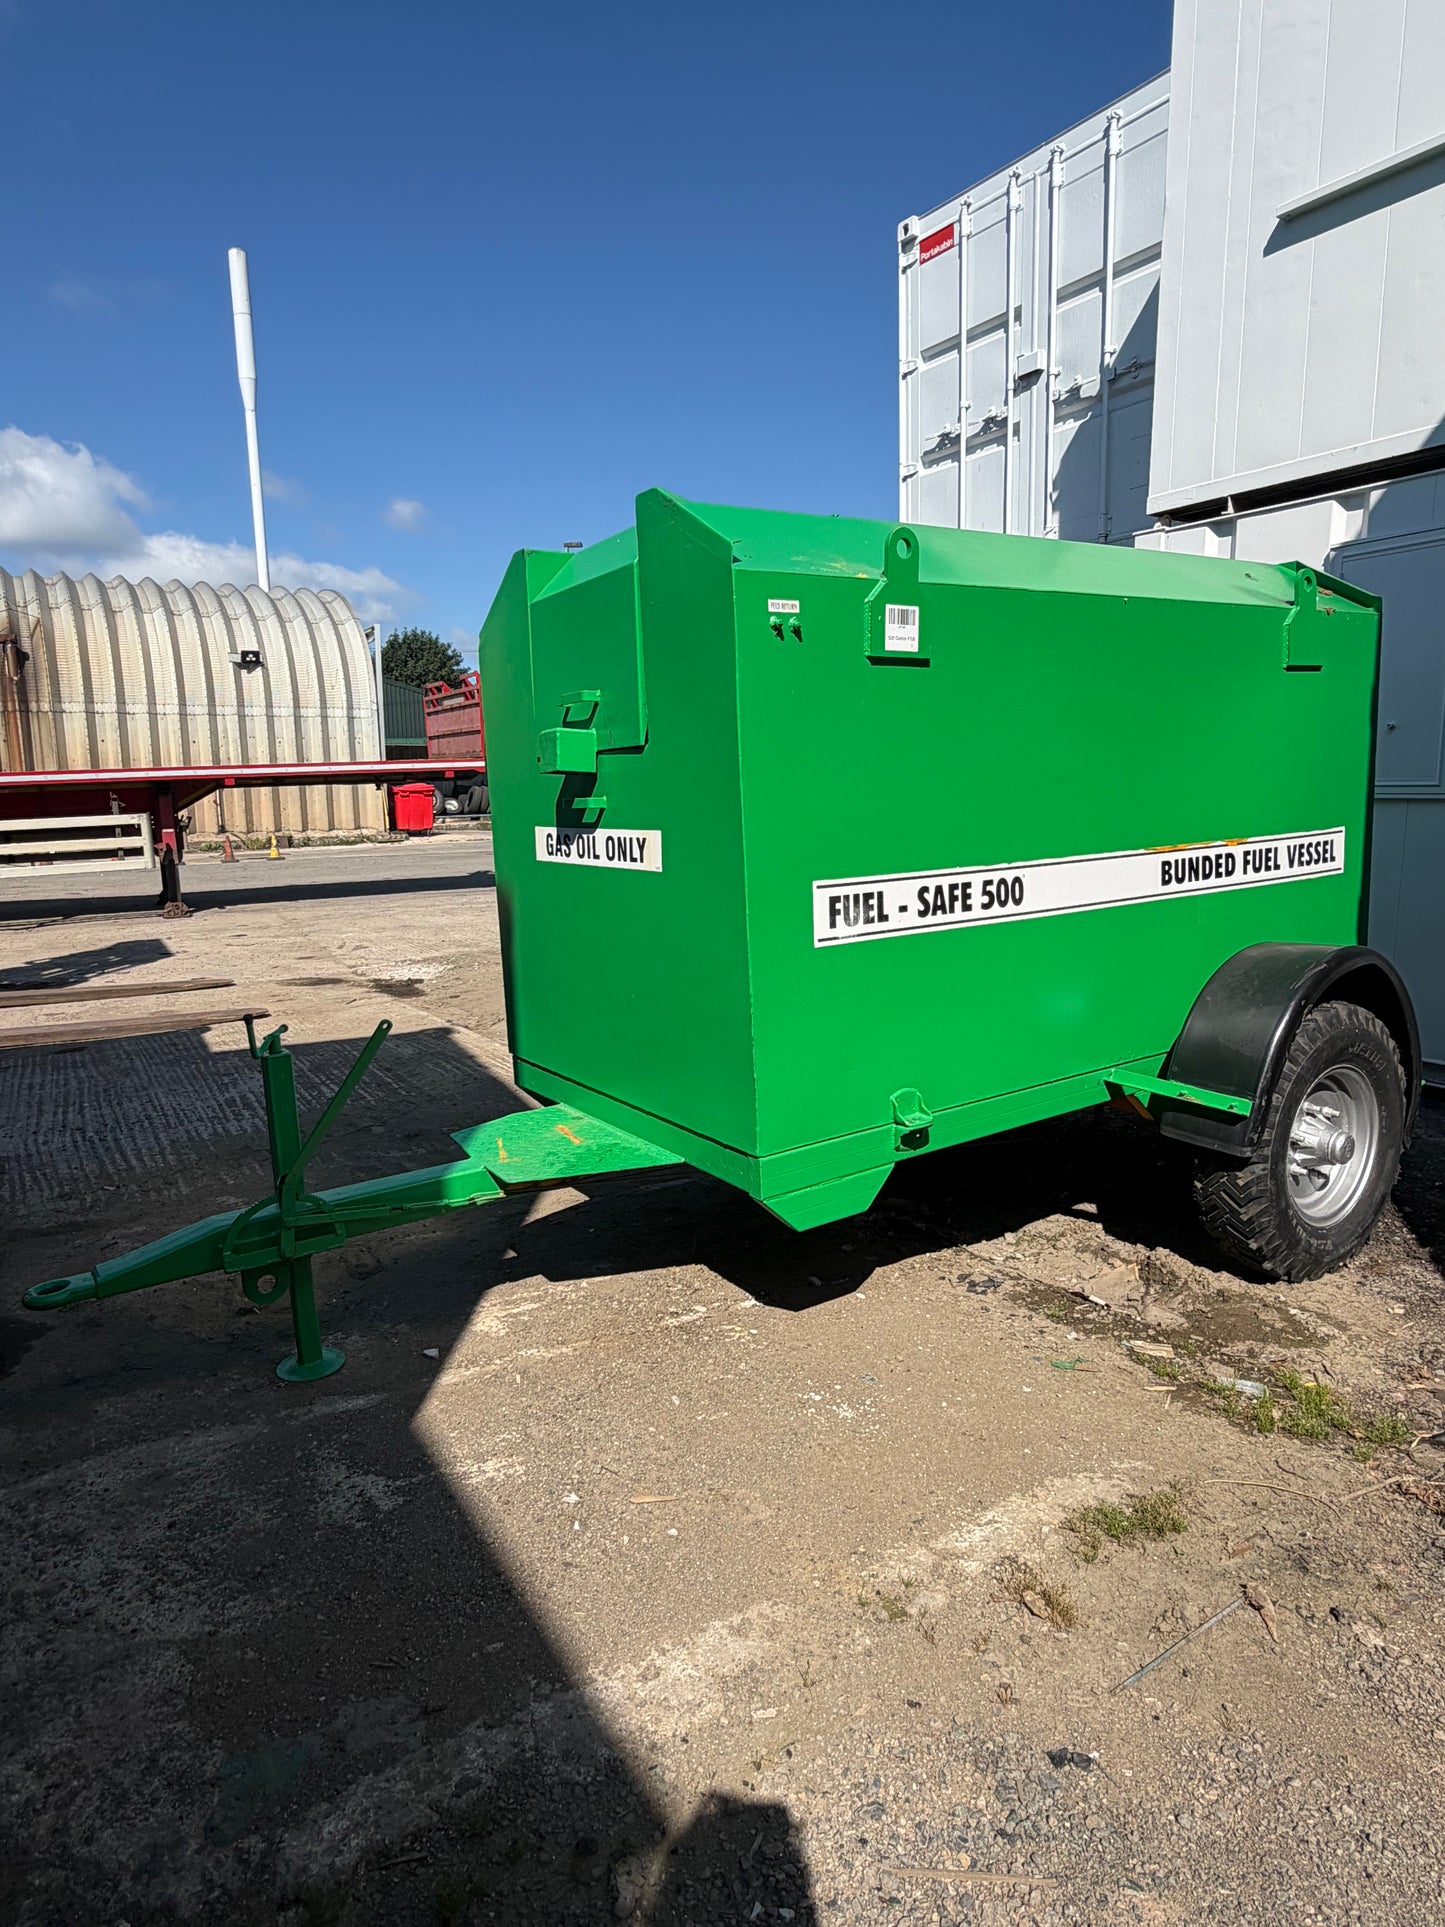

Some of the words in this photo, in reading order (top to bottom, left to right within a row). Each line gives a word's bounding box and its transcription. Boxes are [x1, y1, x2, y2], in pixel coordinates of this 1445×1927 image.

[920, 238, 953, 262] Portakabin
[770, 601, 781, 610] FEED
[781, 602, 798, 611] RETURN
[546, 833, 572, 858] GAS
[576, 834, 600, 860] OIL
[605, 835, 647, 863] ONLY
[1161, 852, 1236, 886] BUNDED
[1242, 847, 1281, 875] FUEL
[1287, 839, 1336, 869] VESSEL
[829, 891, 889, 929] FUEL
[917, 881, 973, 918] SAFE
[980, 876, 1024, 910] 500
